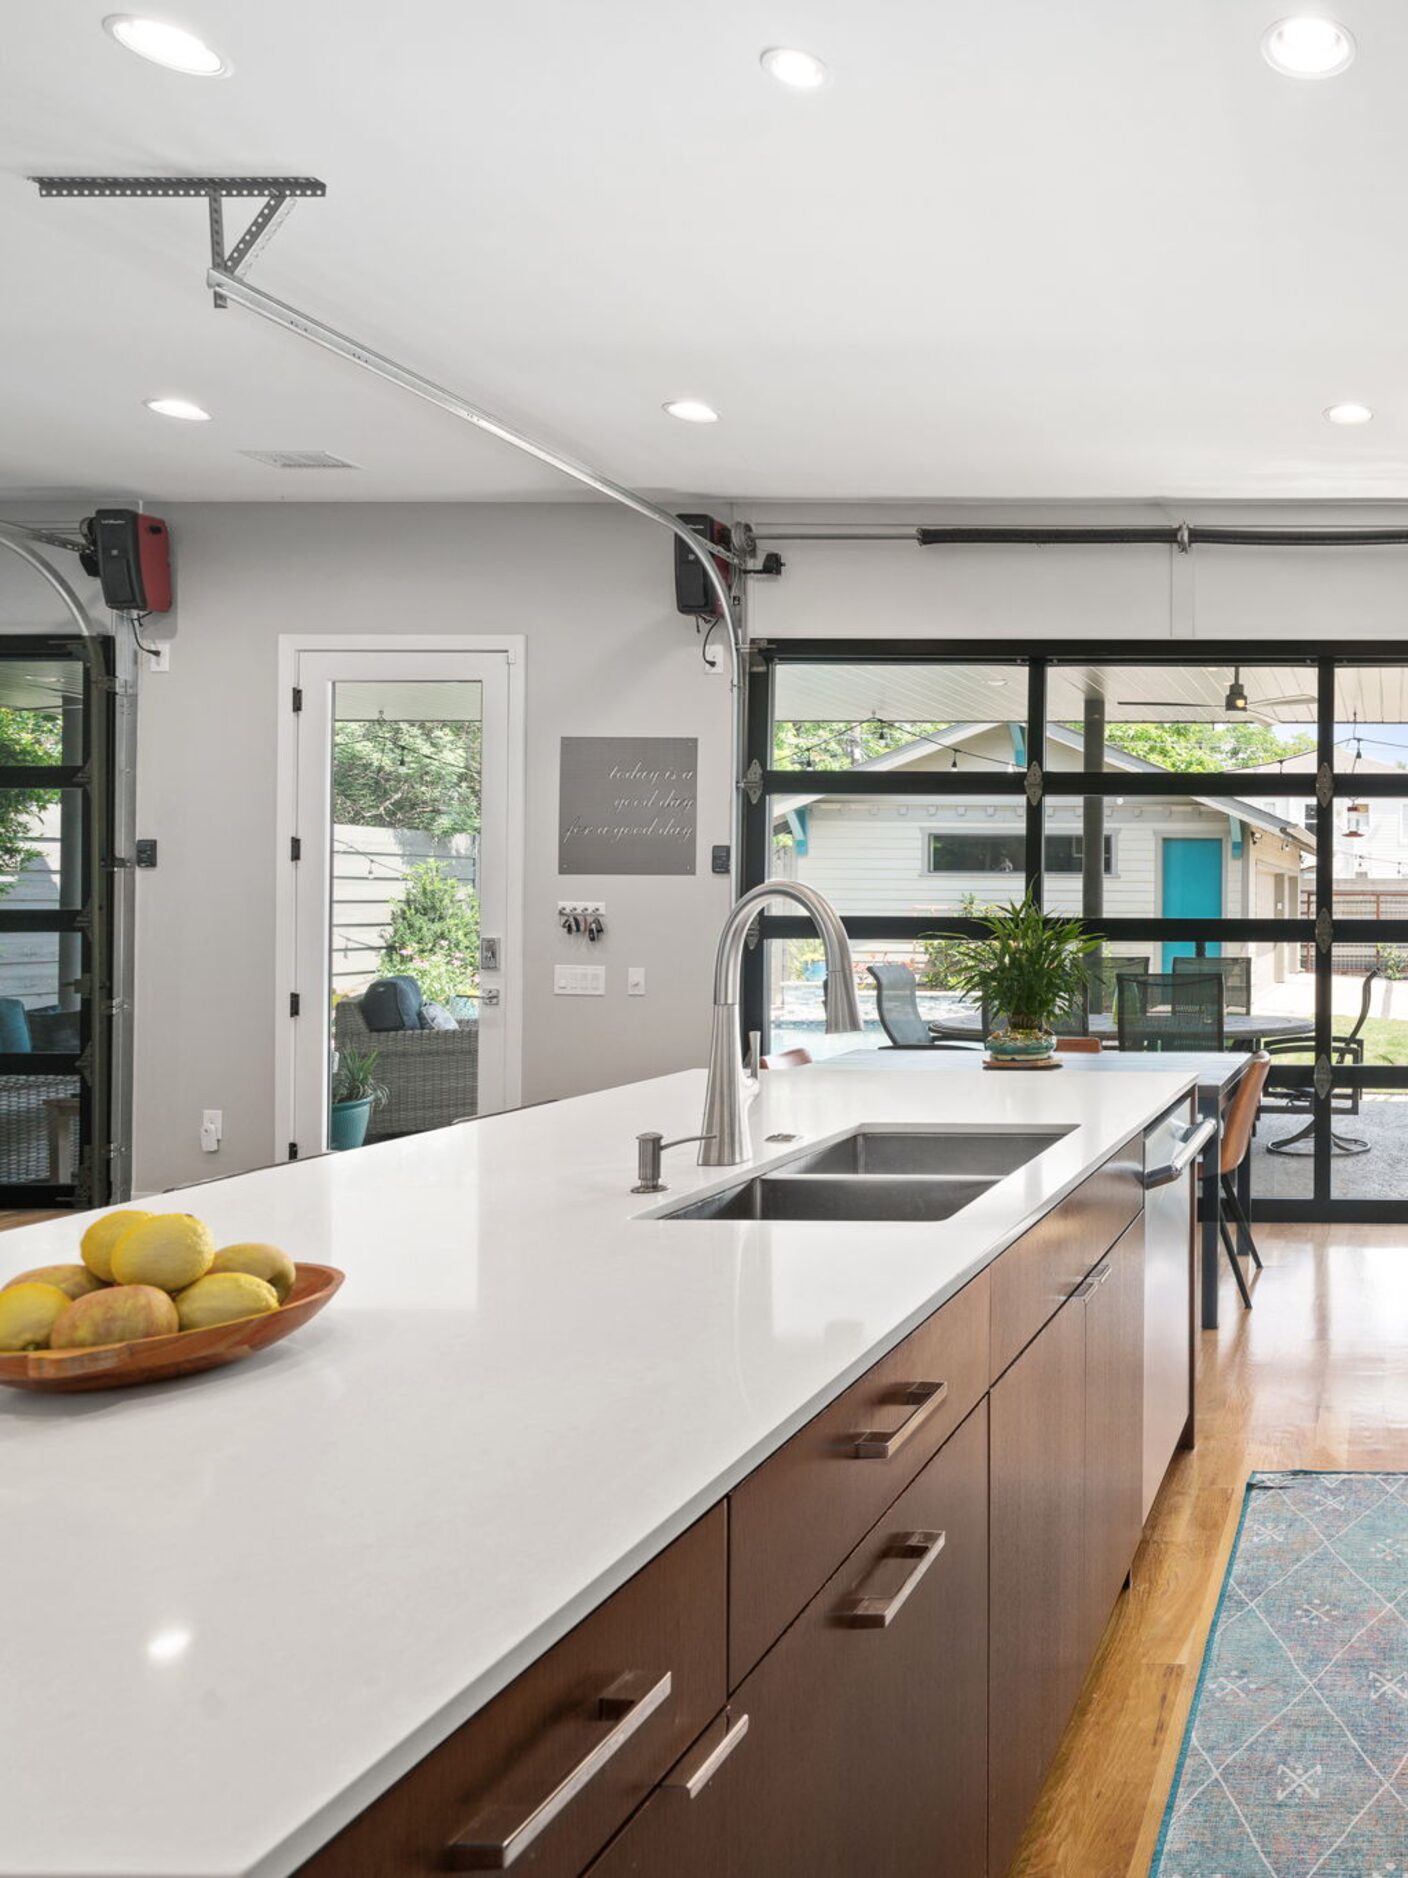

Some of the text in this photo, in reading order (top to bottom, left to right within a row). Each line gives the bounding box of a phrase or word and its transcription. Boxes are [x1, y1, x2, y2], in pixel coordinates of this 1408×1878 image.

[609, 760, 694, 783] today is a
[613, 789, 694, 814] good day
[563, 815, 693, 845] for a good day
